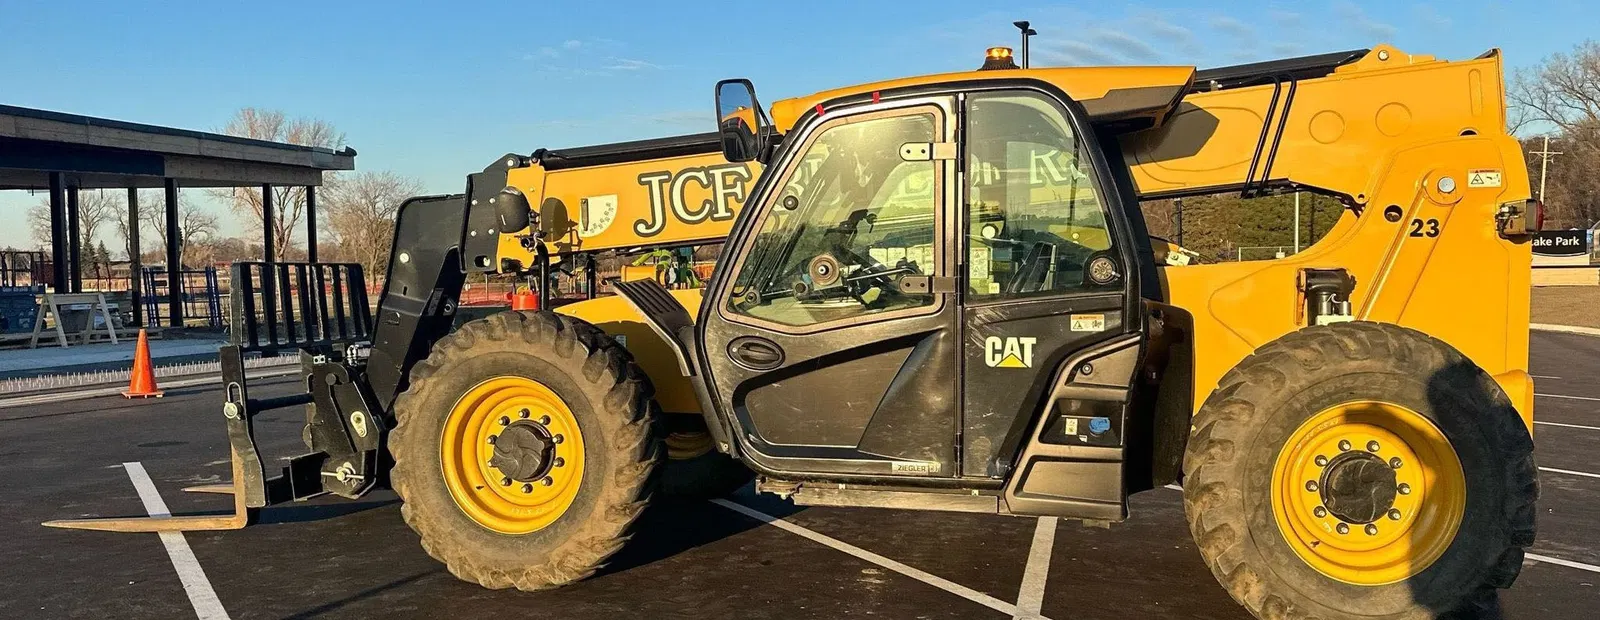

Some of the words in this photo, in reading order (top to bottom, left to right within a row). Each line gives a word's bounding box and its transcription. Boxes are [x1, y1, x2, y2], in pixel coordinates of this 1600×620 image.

[1409, 219, 1440, 238] 23
[1531, 236, 1552, 247] ake
[1555, 236, 1580, 246] Park
[985, 336, 1037, 368] CAT
